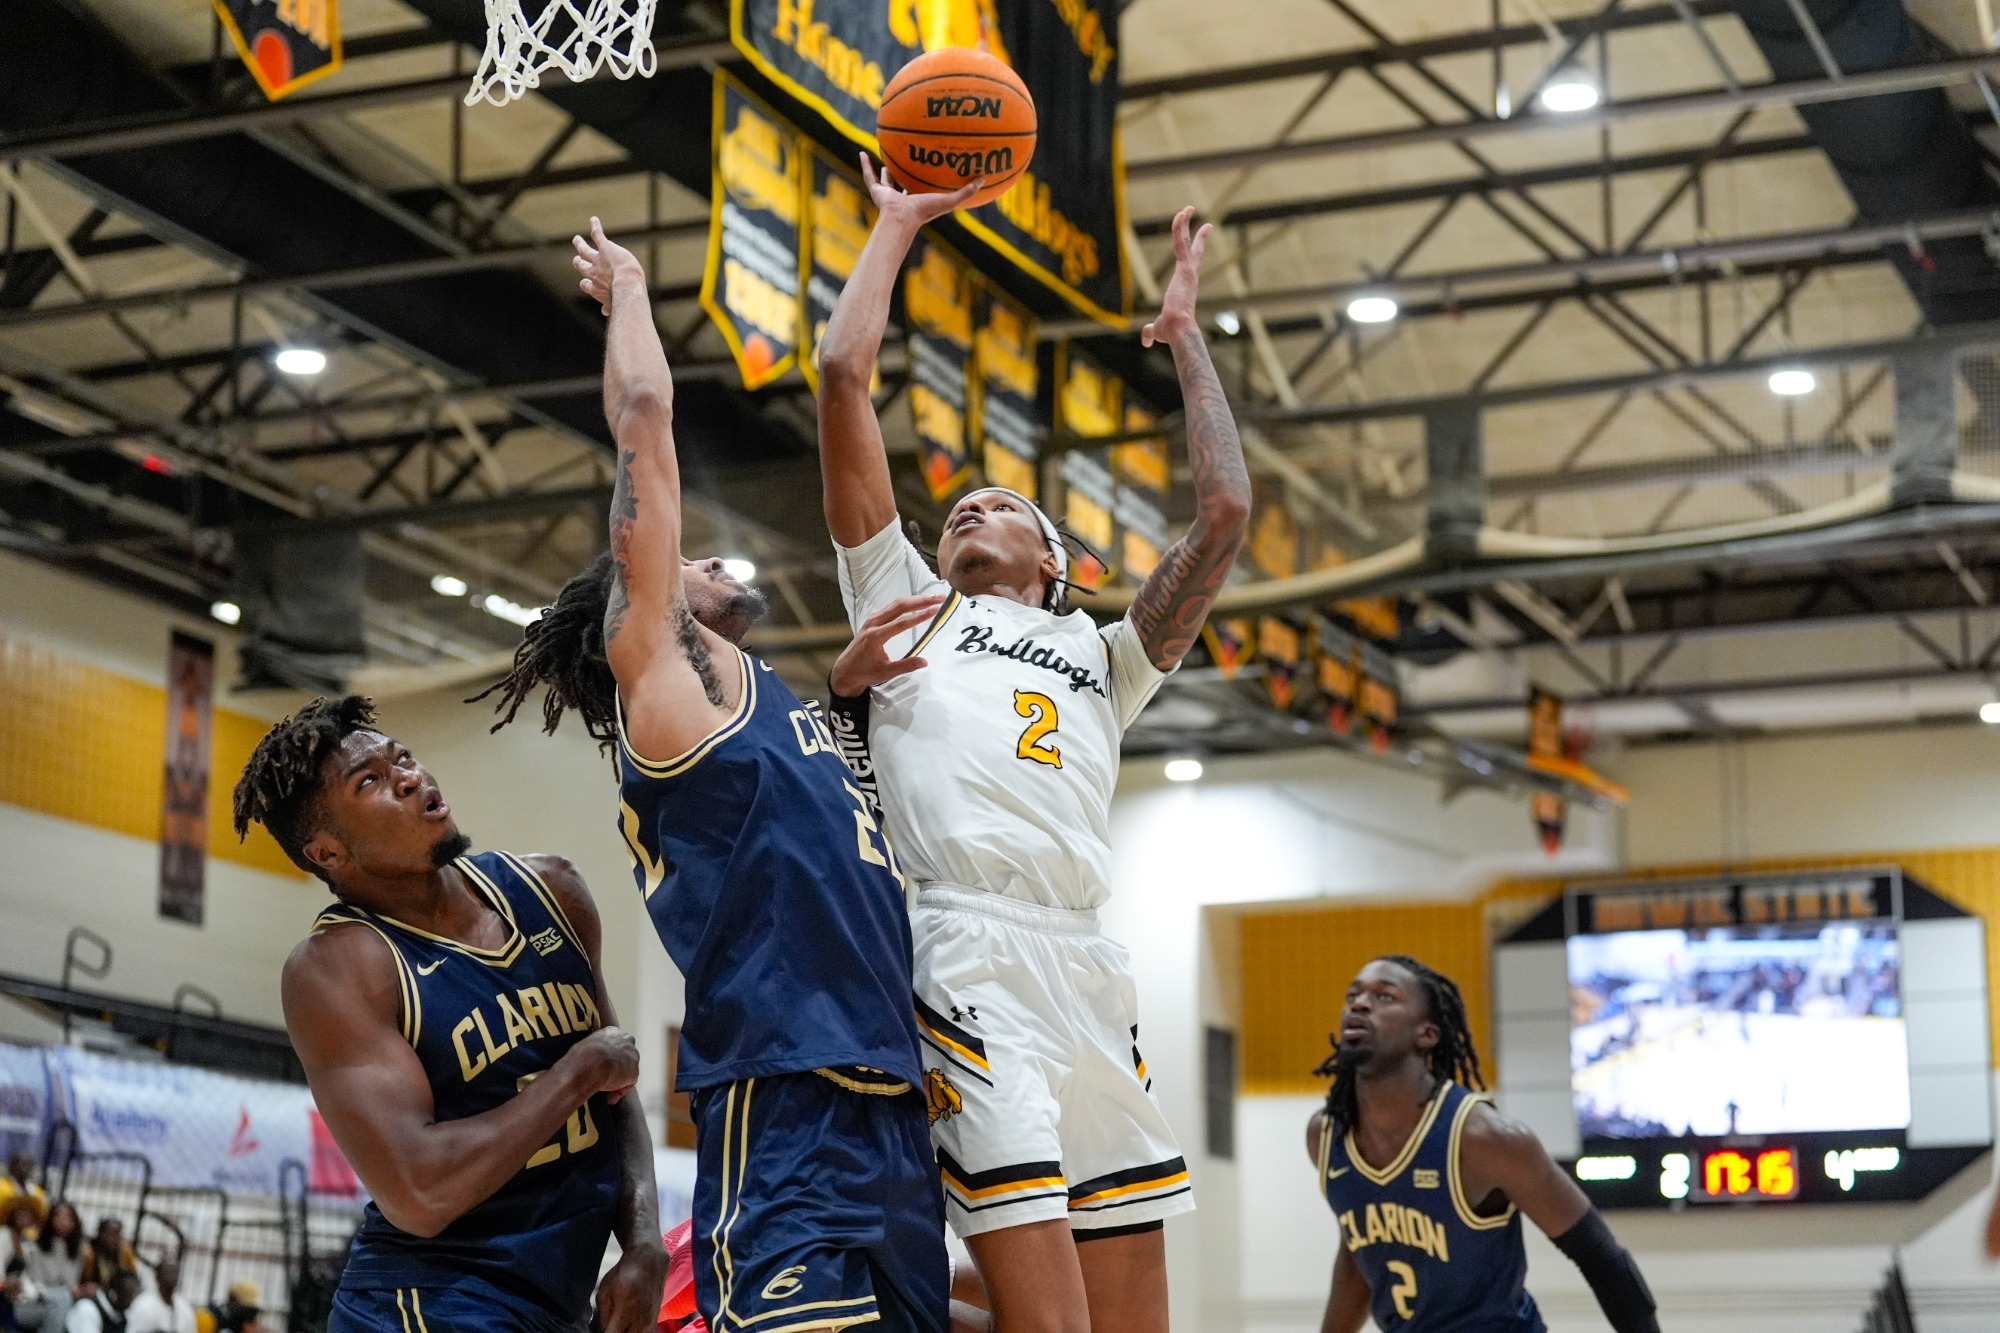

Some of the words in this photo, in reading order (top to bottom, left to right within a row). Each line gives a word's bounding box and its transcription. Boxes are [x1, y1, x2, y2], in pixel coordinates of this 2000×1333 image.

[927, 96, 1002, 118] NCAA
[909, 144, 1013, 177] Wilson
[1013, 688, 1062, 769] 2
[532, 929, 562, 952] PSAC
[1386, 1260, 1418, 1320] 2
